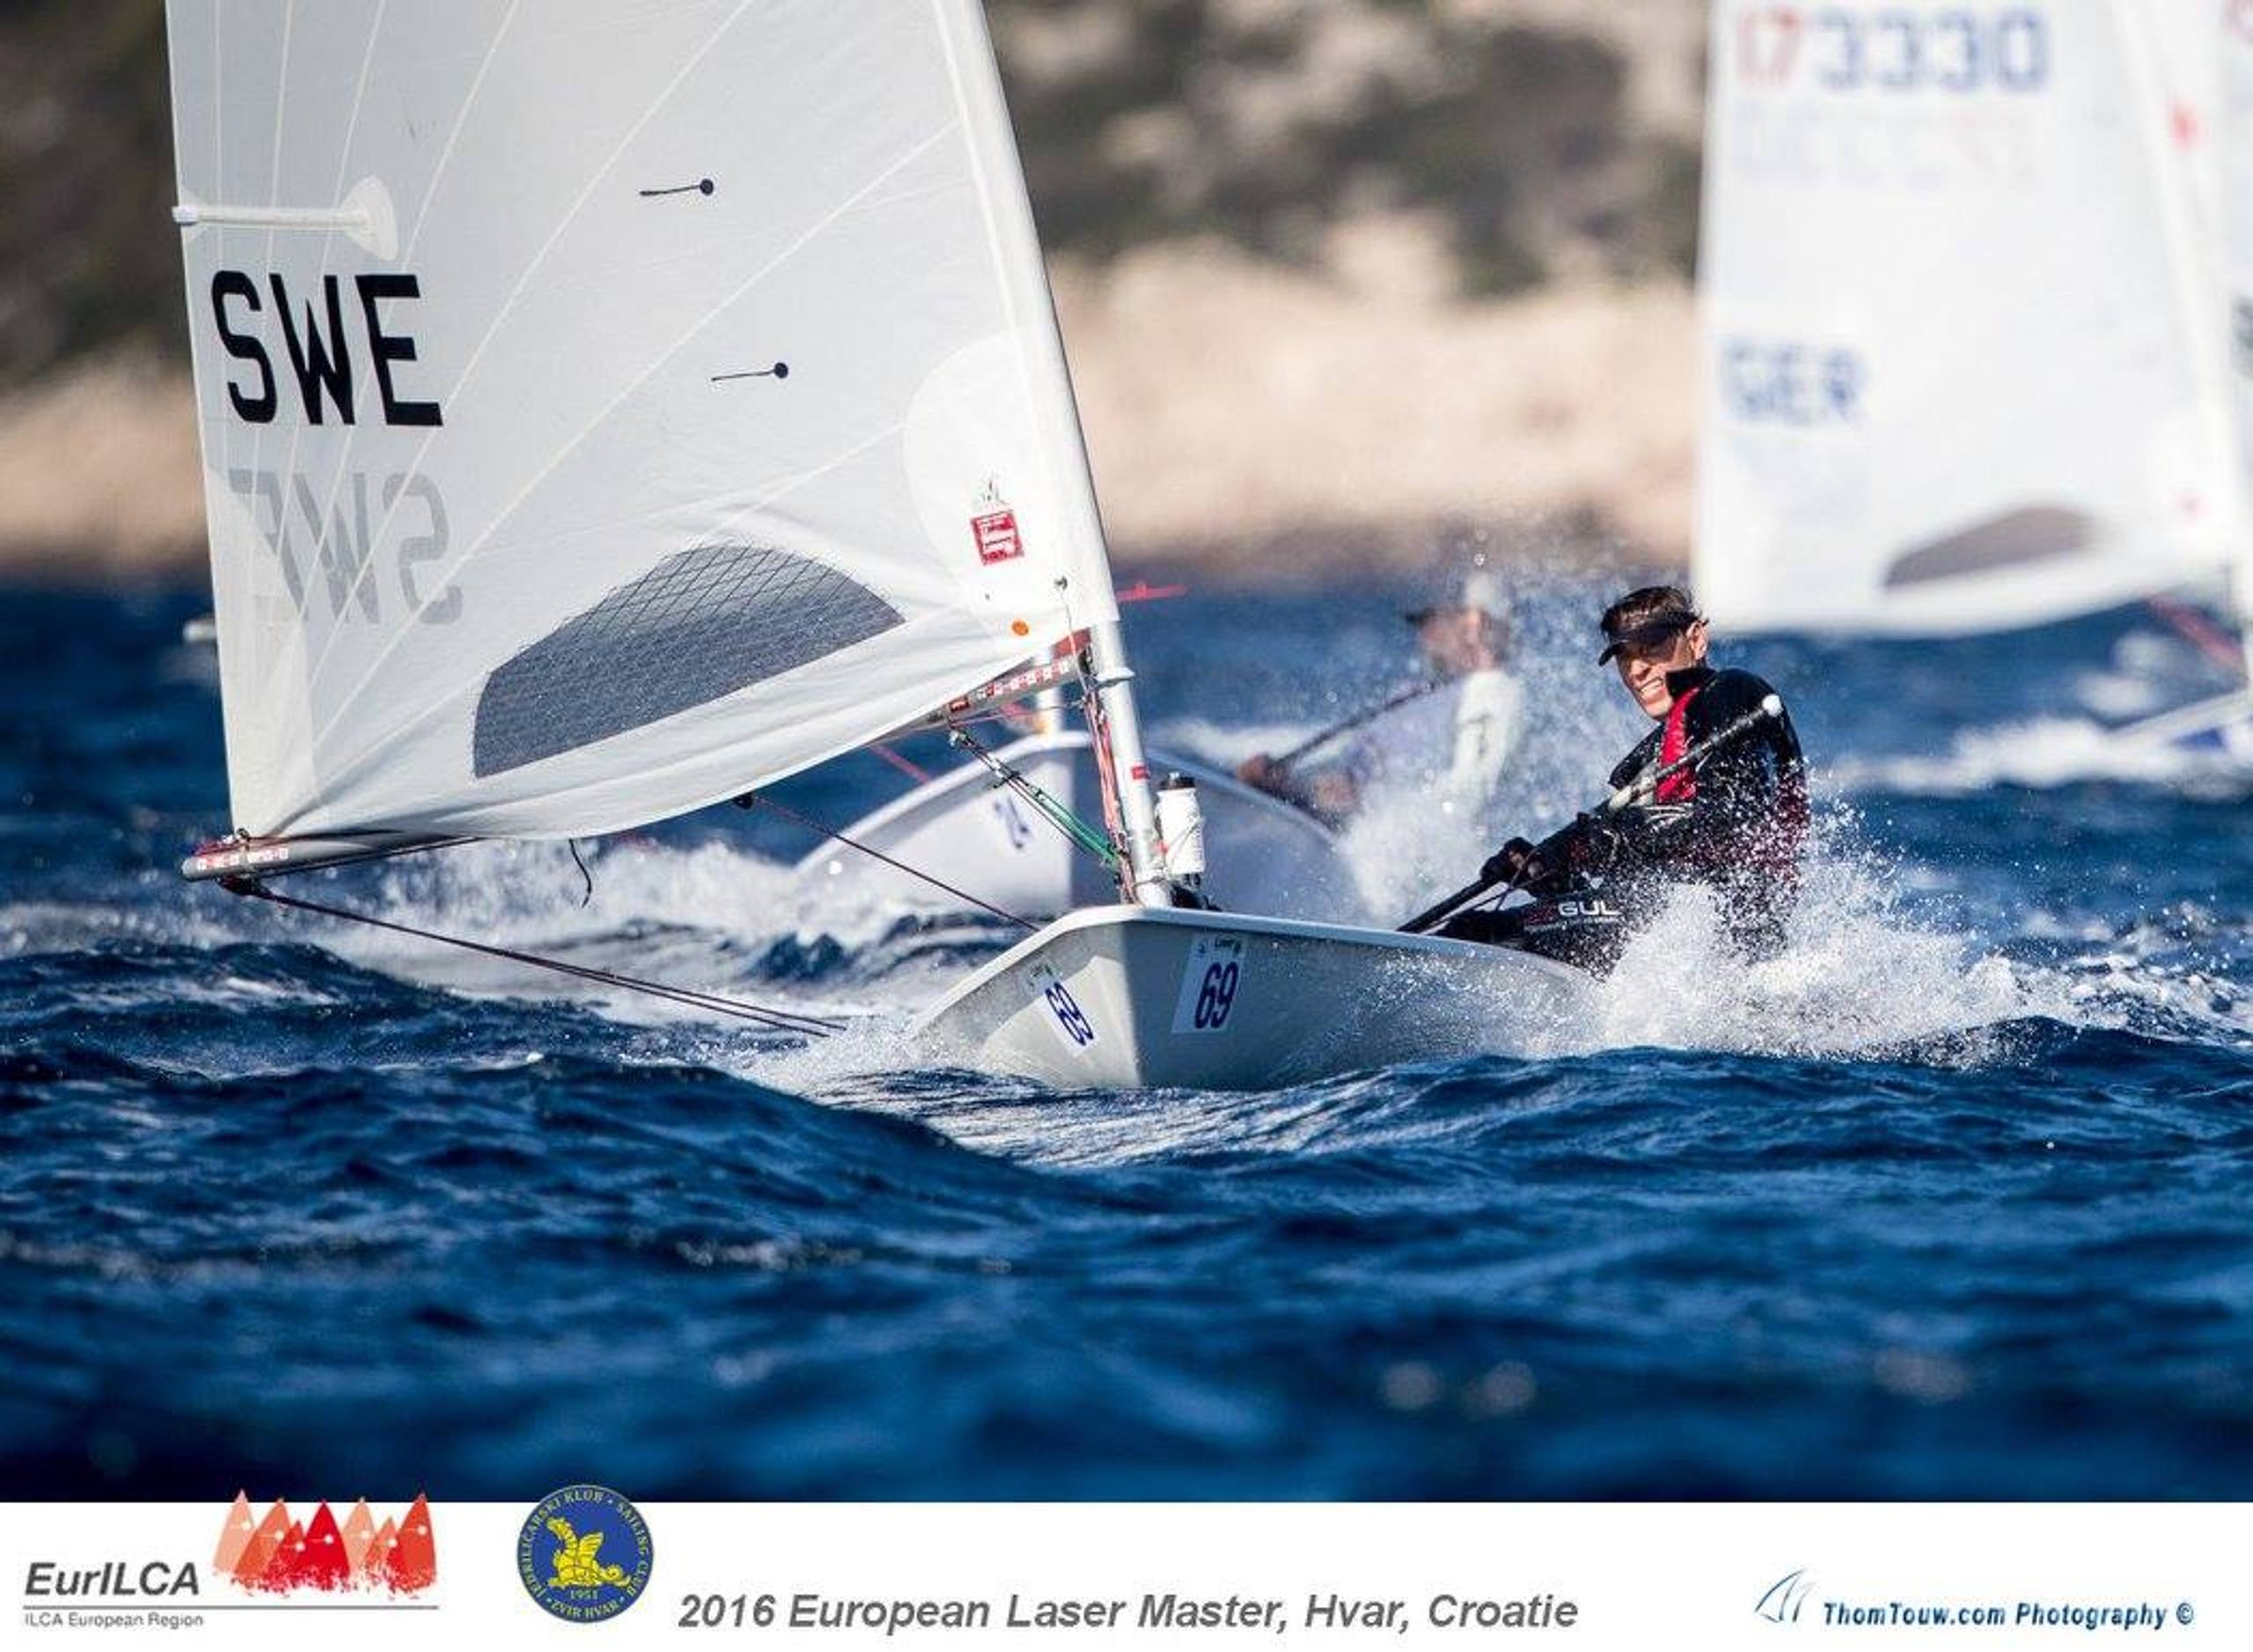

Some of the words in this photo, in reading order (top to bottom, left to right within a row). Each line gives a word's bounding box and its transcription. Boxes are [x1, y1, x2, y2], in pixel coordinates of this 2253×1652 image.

[211, 270, 443, 426] SWE
[1722, 341, 1864, 426] GER
[1558, 899, 1622, 916] GUL
[1045, 981, 1094, 1046] 69
[1195, 961, 1239, 1029] 69
